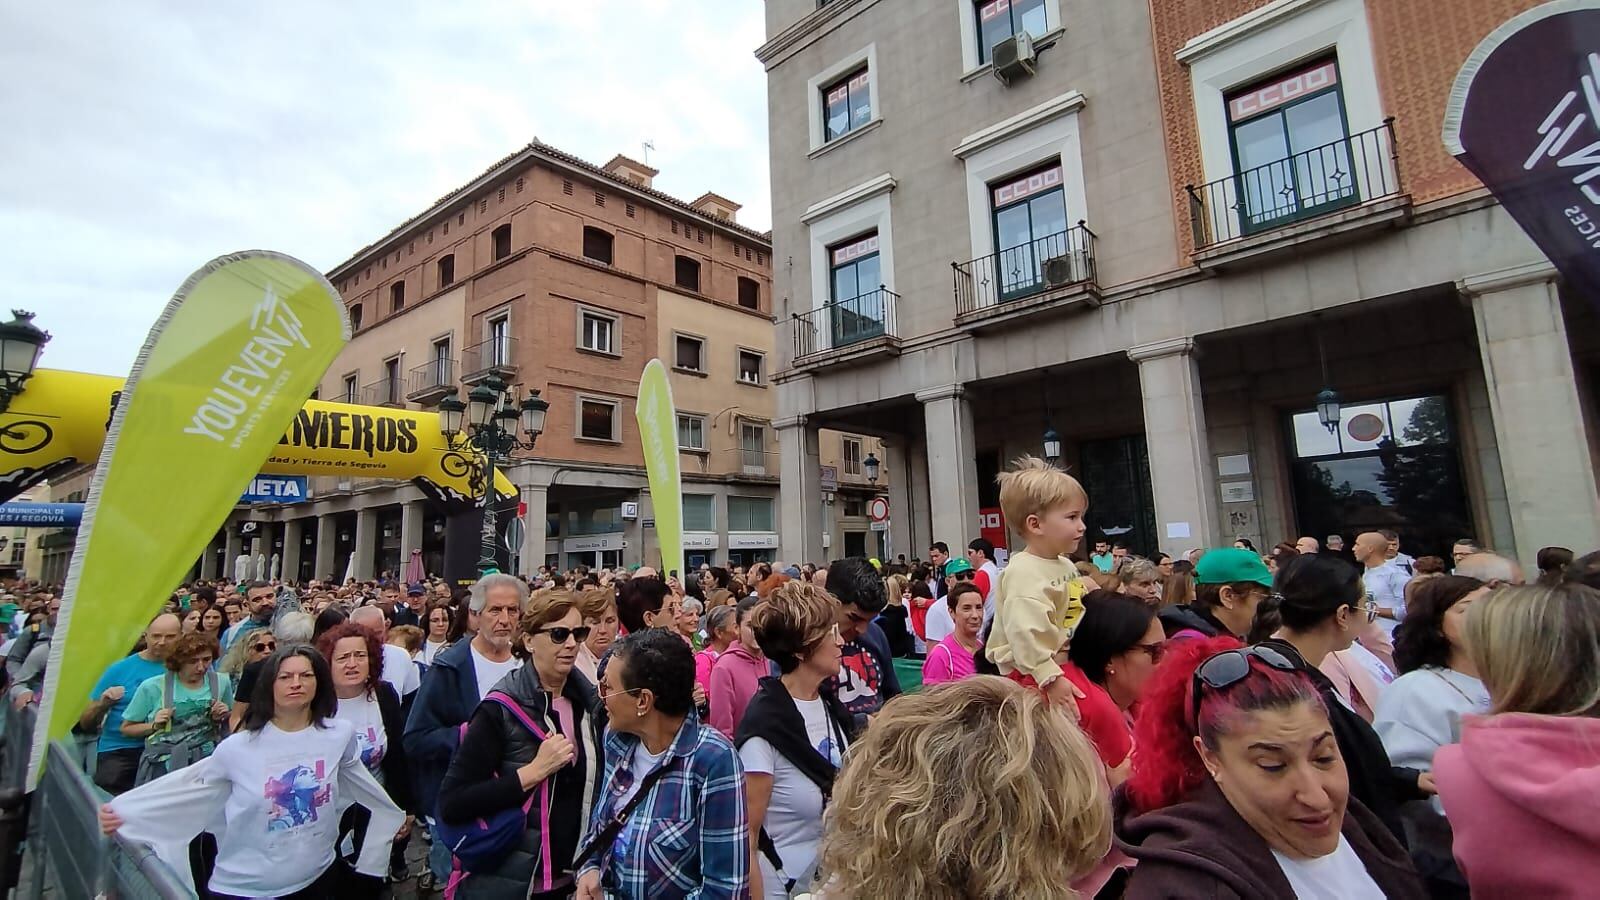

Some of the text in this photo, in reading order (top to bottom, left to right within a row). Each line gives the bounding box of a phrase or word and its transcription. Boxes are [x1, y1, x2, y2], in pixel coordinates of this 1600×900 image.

[1236, 68, 1328, 115] CCOO
[999, 167, 1059, 202] CCOO
[835, 237, 879, 265] CCOO
[302, 458, 332, 466] Tierra
[350, 461, 387, 469] Segovia
